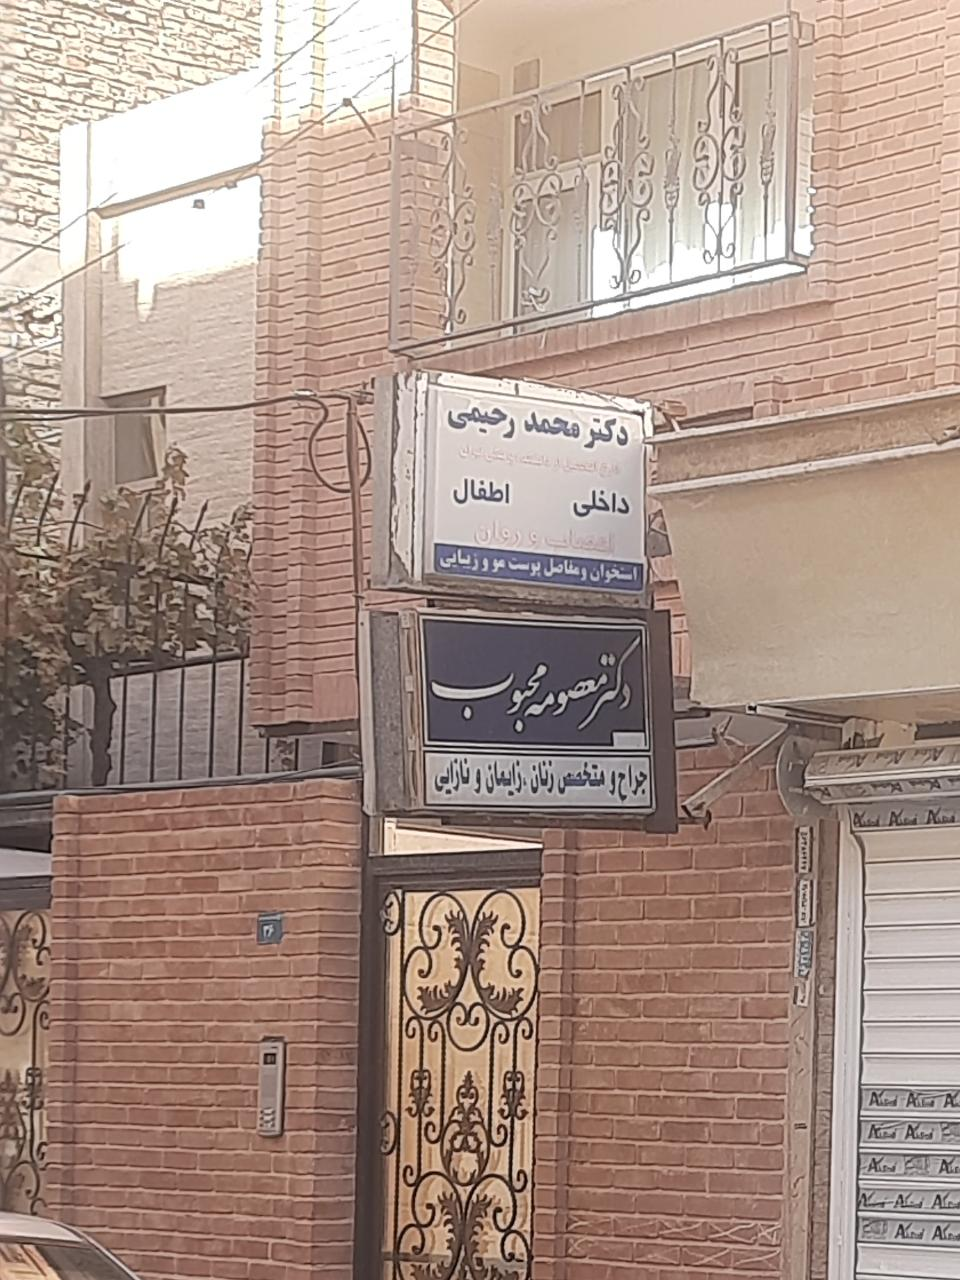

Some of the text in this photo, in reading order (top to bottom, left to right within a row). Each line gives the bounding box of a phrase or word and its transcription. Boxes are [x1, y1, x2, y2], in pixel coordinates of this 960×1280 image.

[448, 404, 629, 449] دکتر محمد رحیمی
[453, 478, 510, 504] اطفال
[573, 490, 630, 516] داخلی
[439, 549, 479, 571] زیبایی
[482, 557, 489, 571] و
[492, 557, 505, 574] مو
[590, 562, 638, 584] استخوان
[578, 635, 641, 731] دکتر
[431, 663, 549, 733] محبوب
[434, 757, 470, 795] نازایی
[474, 767, 482, 794] و
[530, 759, 554, 795] زنان
[558, 761, 606, 795] متخصص
[609, 770, 617, 796] و
[618, 764, 648, 803] جراح
